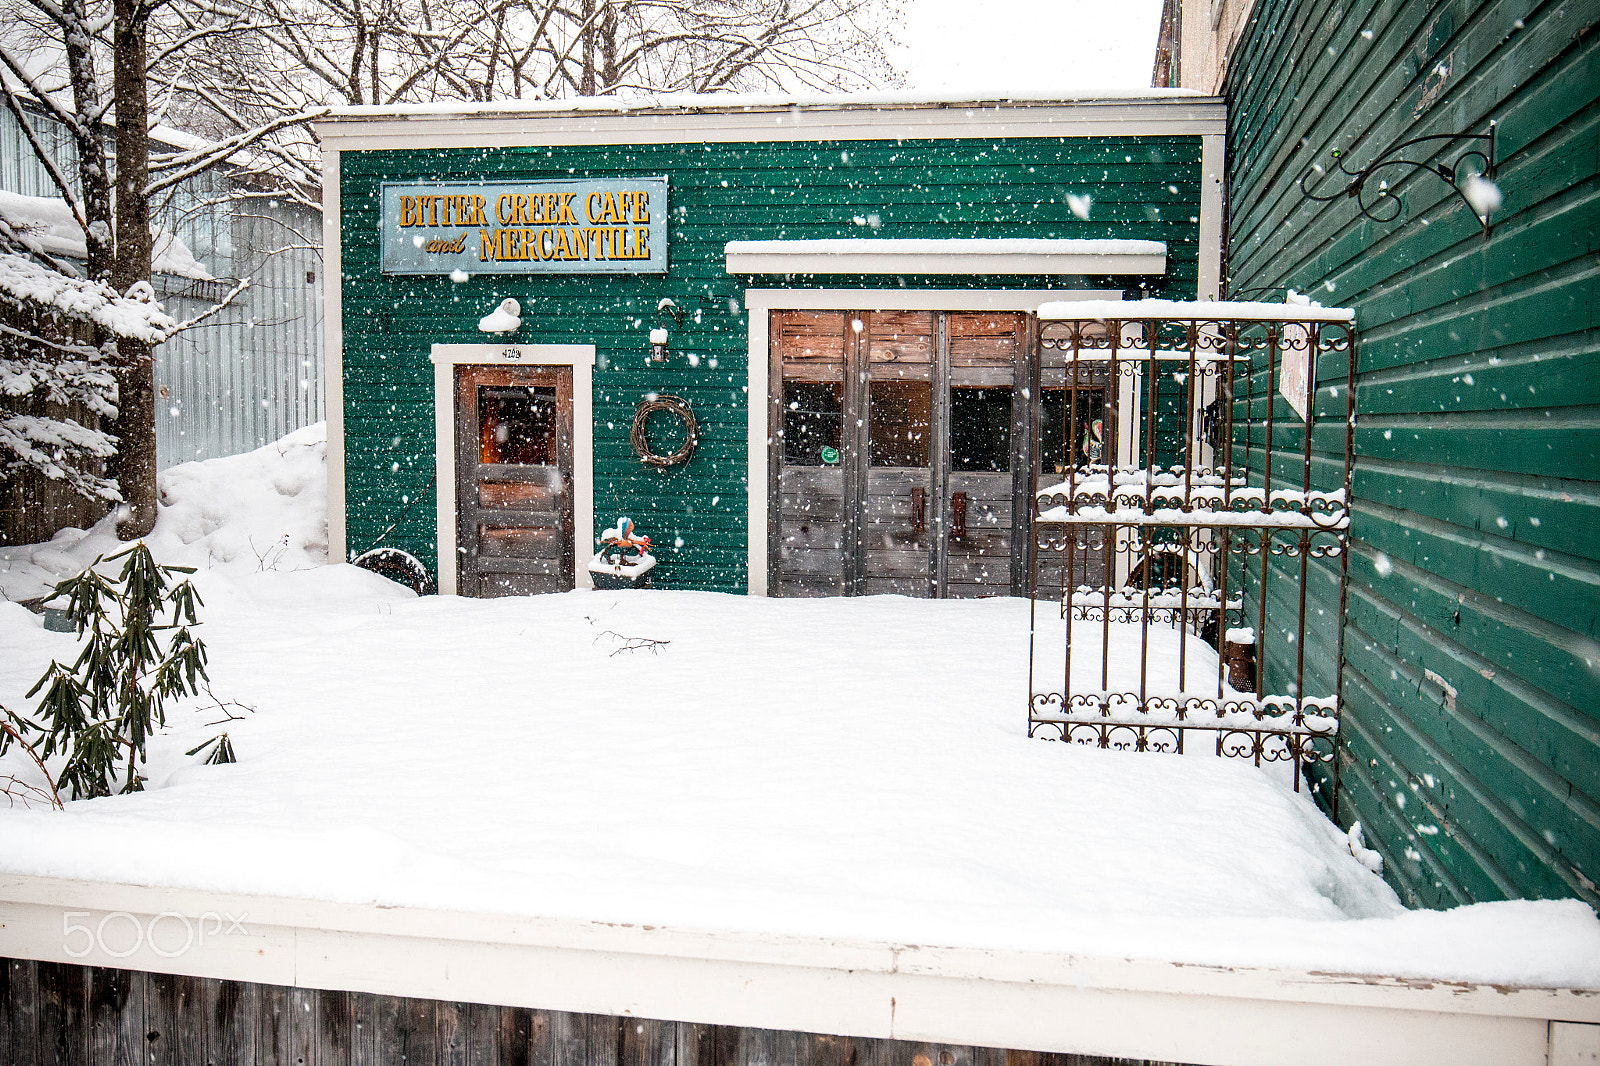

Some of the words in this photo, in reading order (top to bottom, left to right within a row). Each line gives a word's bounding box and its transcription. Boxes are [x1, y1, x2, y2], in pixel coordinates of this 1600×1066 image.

[399, 194, 488, 228] BITTER
[494, 191, 579, 226] CREEK
[584, 190, 650, 224] CAFE
[425, 231, 468, 256] and
[478, 226, 650, 262] MERCANTILE
